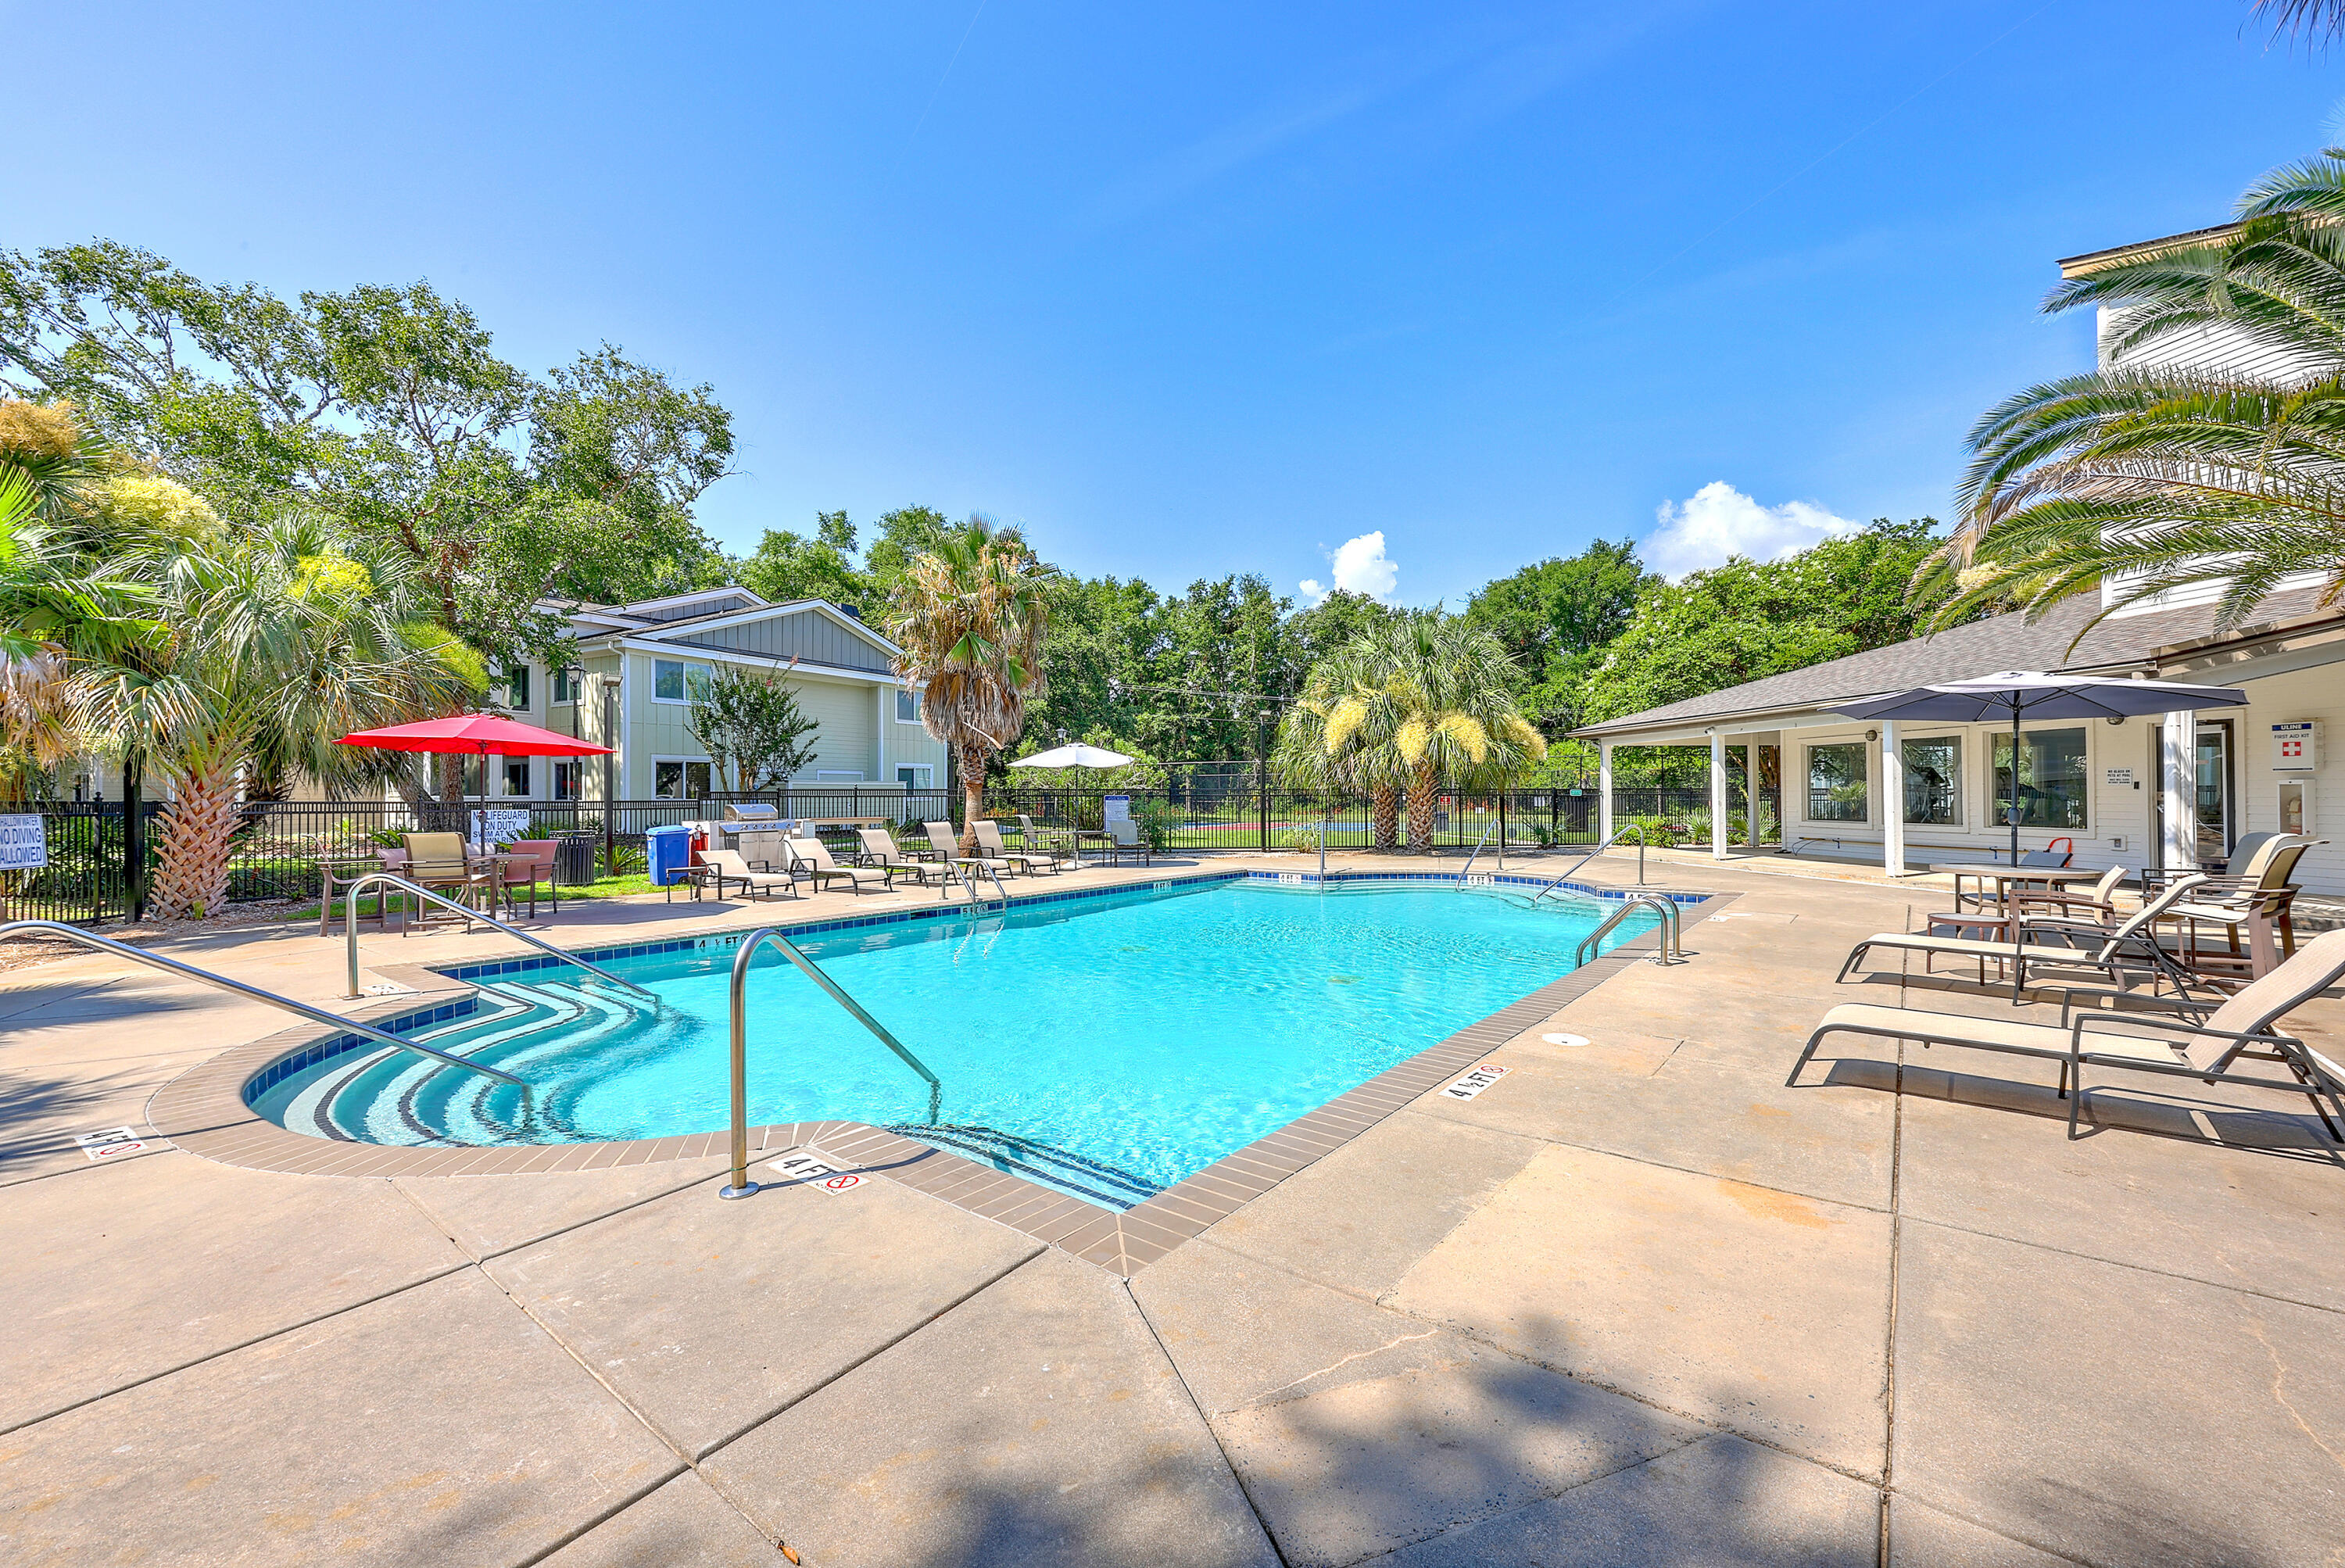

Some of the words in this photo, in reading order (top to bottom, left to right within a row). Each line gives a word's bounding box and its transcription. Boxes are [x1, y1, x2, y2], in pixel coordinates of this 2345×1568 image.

[486, 811, 528, 820] LIFEGUARD
[0, 817, 21, 826] HALLOW
[484, 822, 496, 830] ON
[498, 821, 517, 830] DUTY
[13, 828, 41, 844] DIVING
[0, 847, 42, 865] ALLOWED
[725, 936, 738, 945] FT
[1448, 1089, 1472, 1097] 4
[1467, 1072, 1496, 1083] FT
[783, 1158, 812, 1169] 4
[795, 1165, 838, 1180] FT
